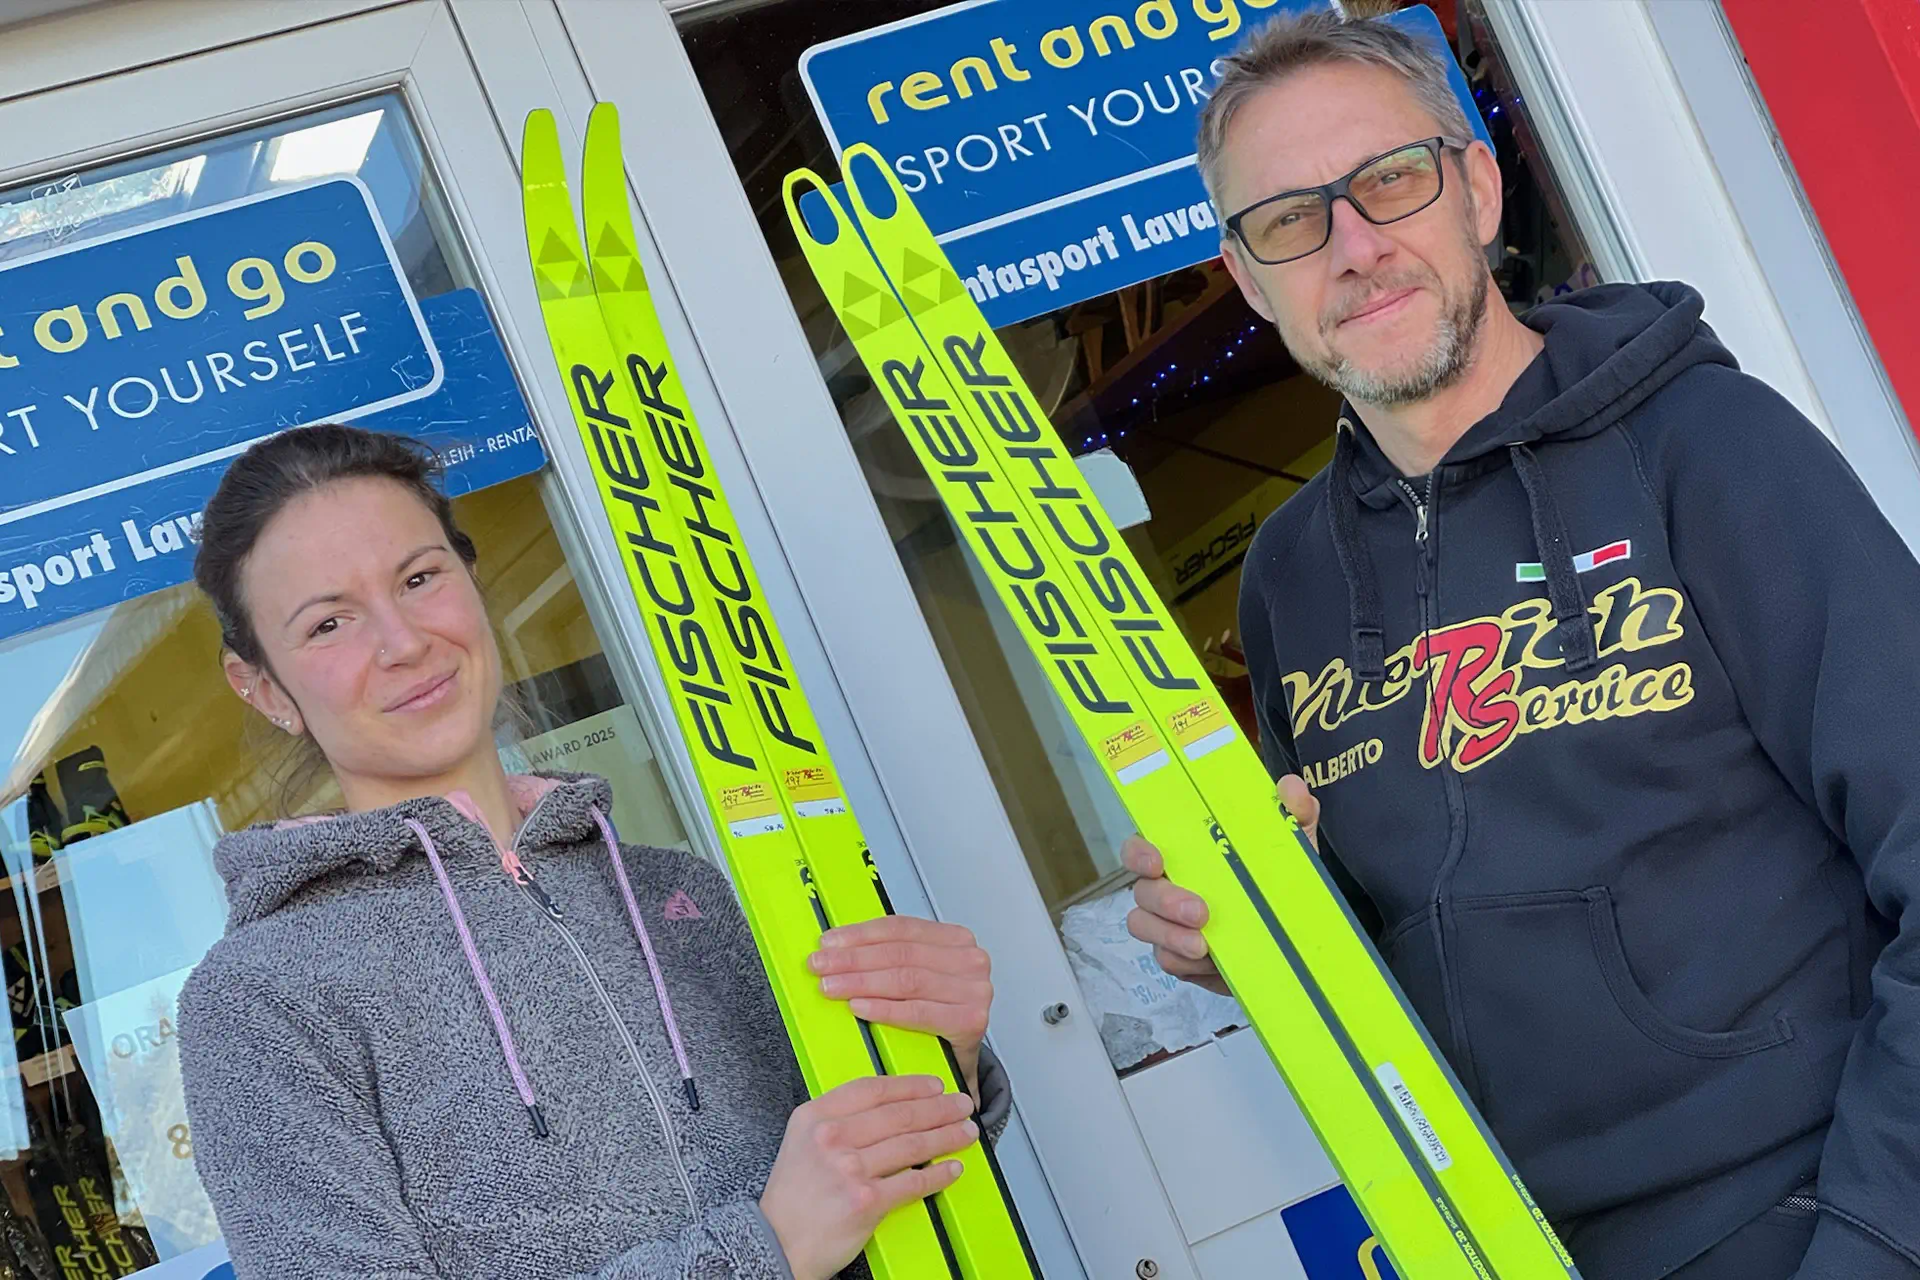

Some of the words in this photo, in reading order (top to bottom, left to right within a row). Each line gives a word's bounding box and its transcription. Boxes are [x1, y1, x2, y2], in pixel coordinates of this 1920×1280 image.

[867, 37, 1031, 125] rent
[1040, 0, 1179, 69] and
[1193, 0, 1279, 42] g
[896, 113, 1052, 193] SPORT
[1121, 199, 1216, 252] Lava
[33, 255, 208, 353] and
[226, 241, 337, 321] go
[63, 312, 367, 431] YOURSELF
[571, 363, 758, 771] FISCHER
[626, 352, 817, 755] FISCHER
[882, 355, 1134, 714] FISCHER
[943, 331, 1201, 691] FISCHER
[583, 727, 616, 748] 2025
[1303, 738, 1384, 789] ALBERTO
